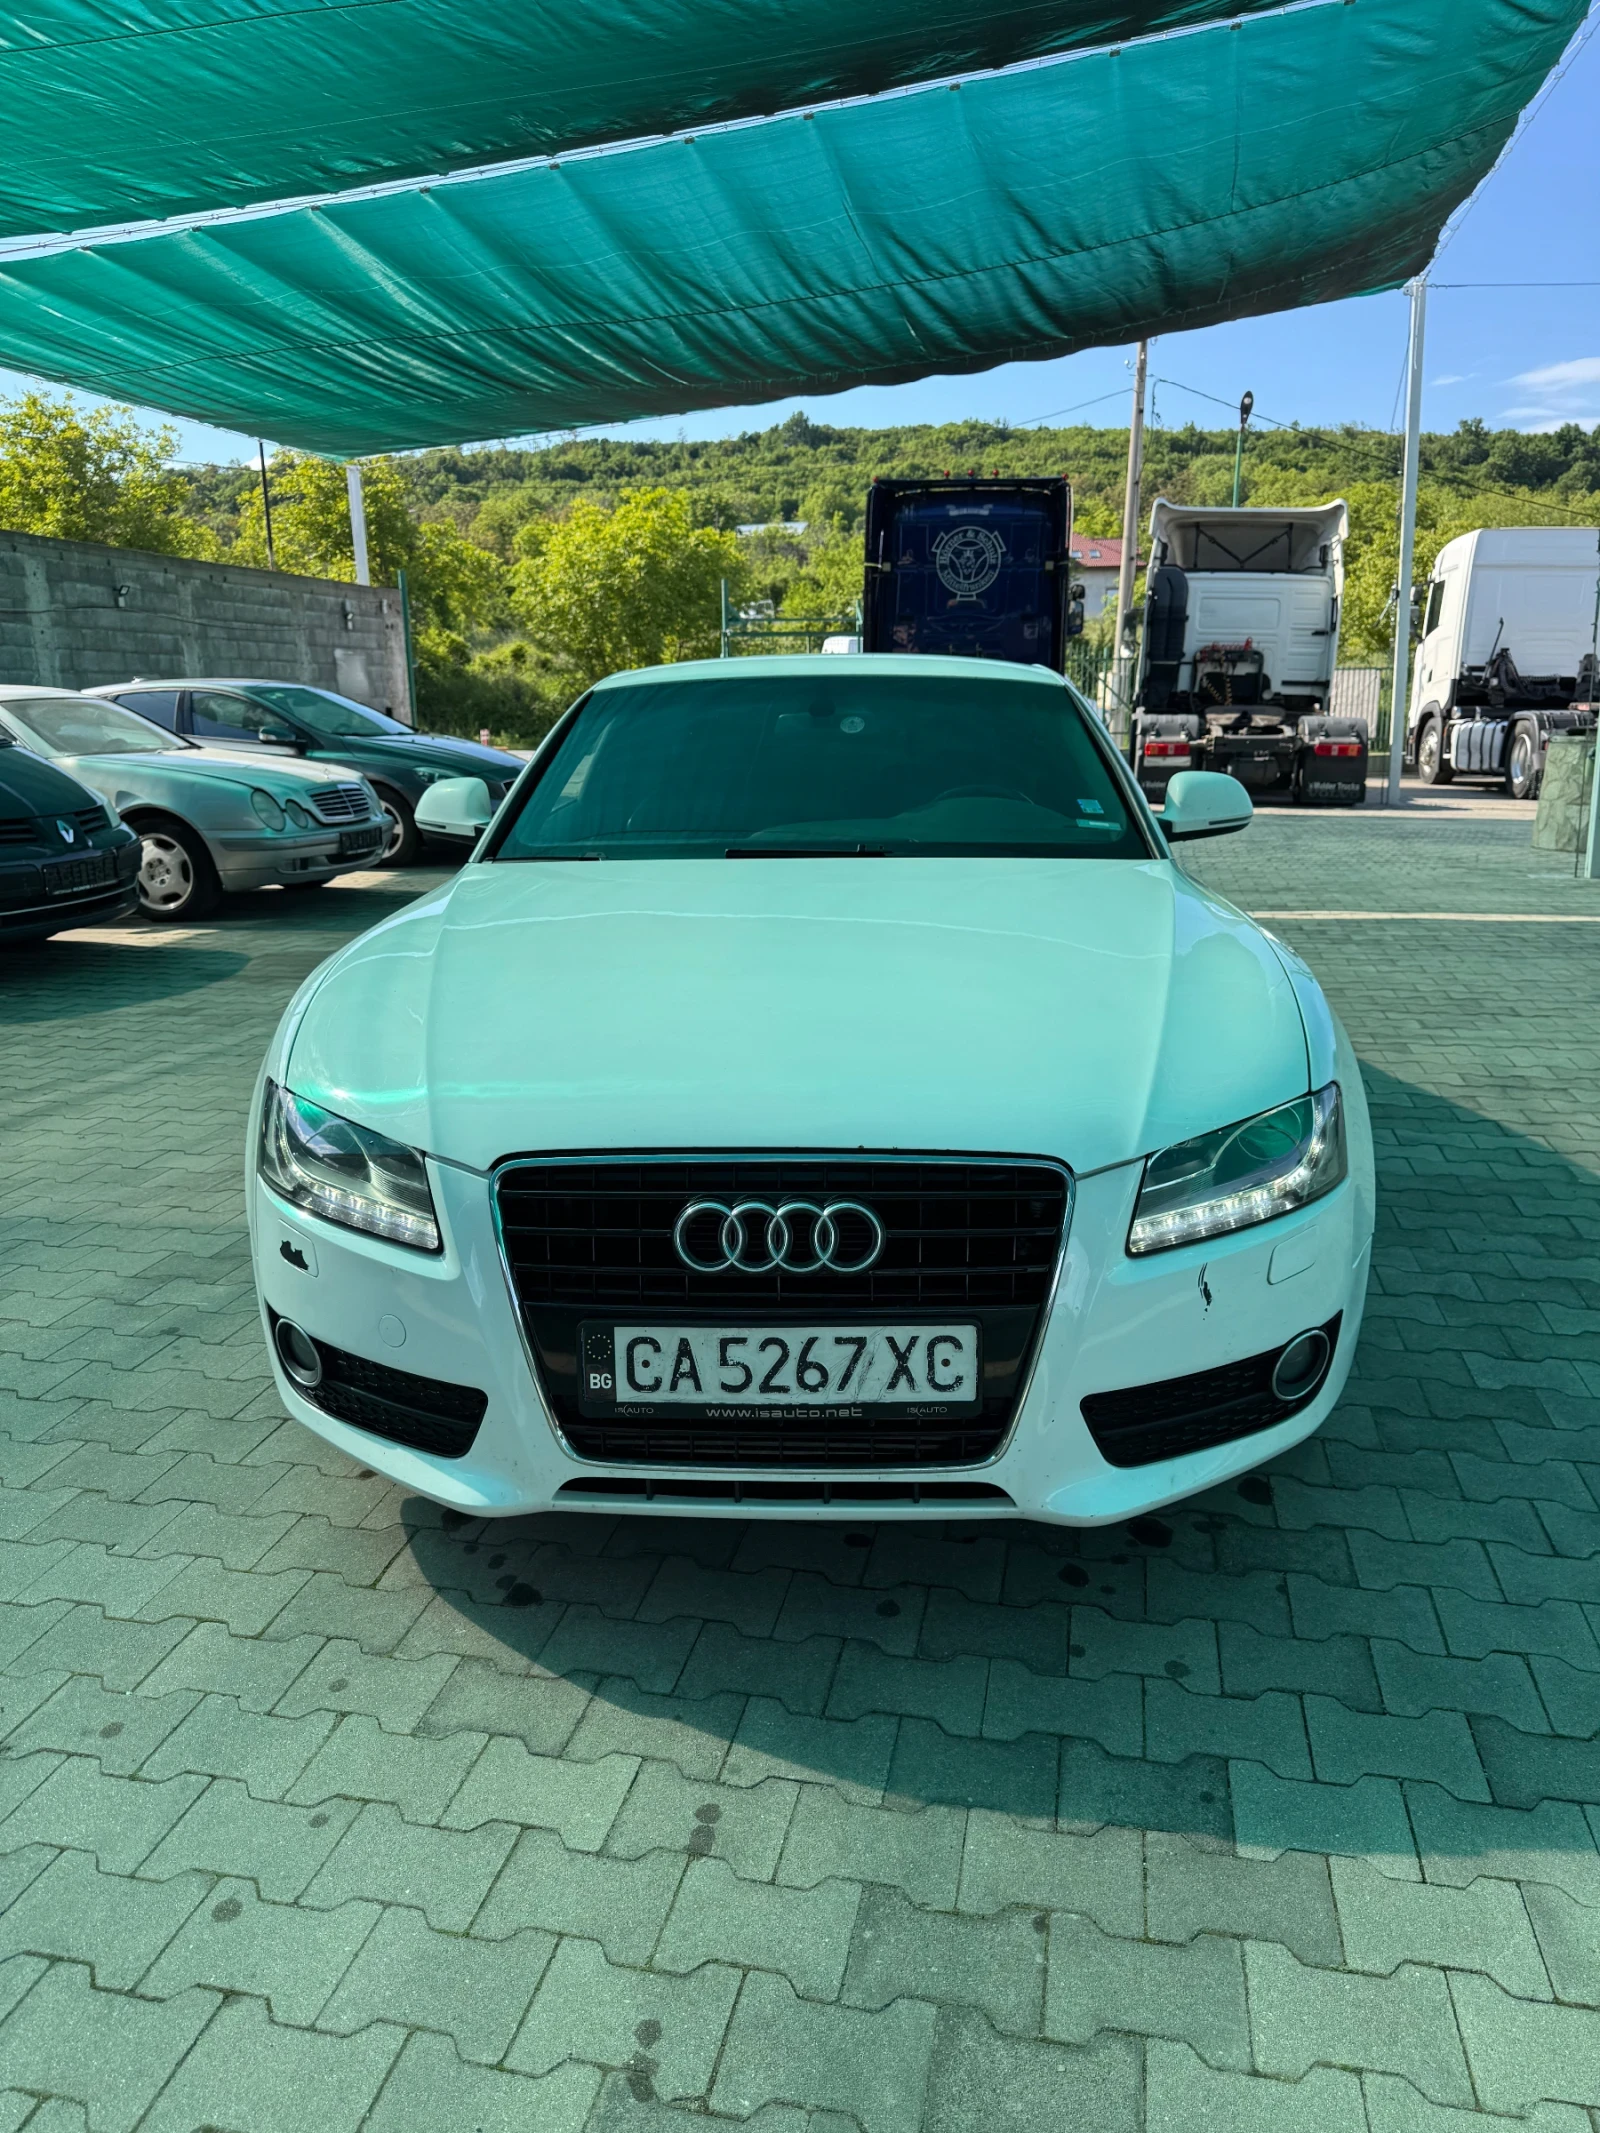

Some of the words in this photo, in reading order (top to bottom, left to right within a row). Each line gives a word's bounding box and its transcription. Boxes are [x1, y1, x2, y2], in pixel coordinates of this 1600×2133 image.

[966, 529, 976, 538] &
[626, 1336, 703, 1393] CA
[718, 1336, 867, 1394] 5267
[885, 1335, 964, 1393] XC
[589, 1373, 613, 1389] BG
[705, 1407, 863, 1418] www.isauto.net
